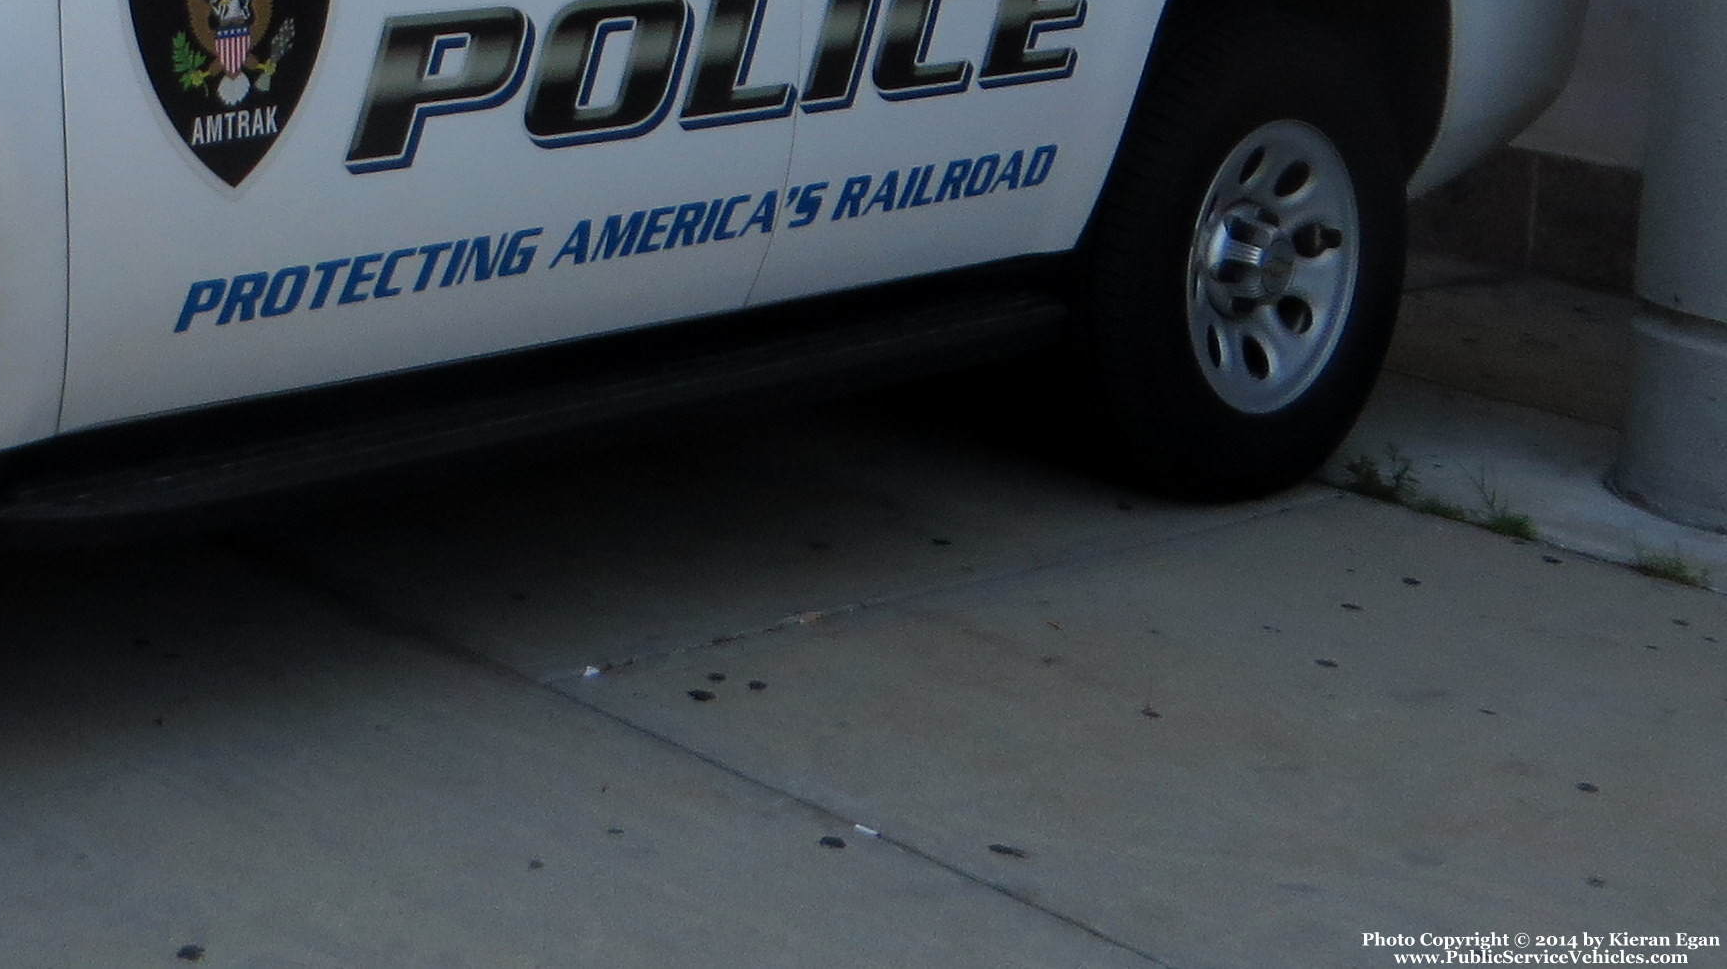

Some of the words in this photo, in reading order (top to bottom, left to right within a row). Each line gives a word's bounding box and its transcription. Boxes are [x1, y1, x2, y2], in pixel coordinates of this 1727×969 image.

[191, 105, 278, 146] AMTRAK
[174, 227, 544, 333] PROTECTING
[549, 181, 829, 269] AMERICA'S
[831, 144, 1058, 221] RAILROAD
